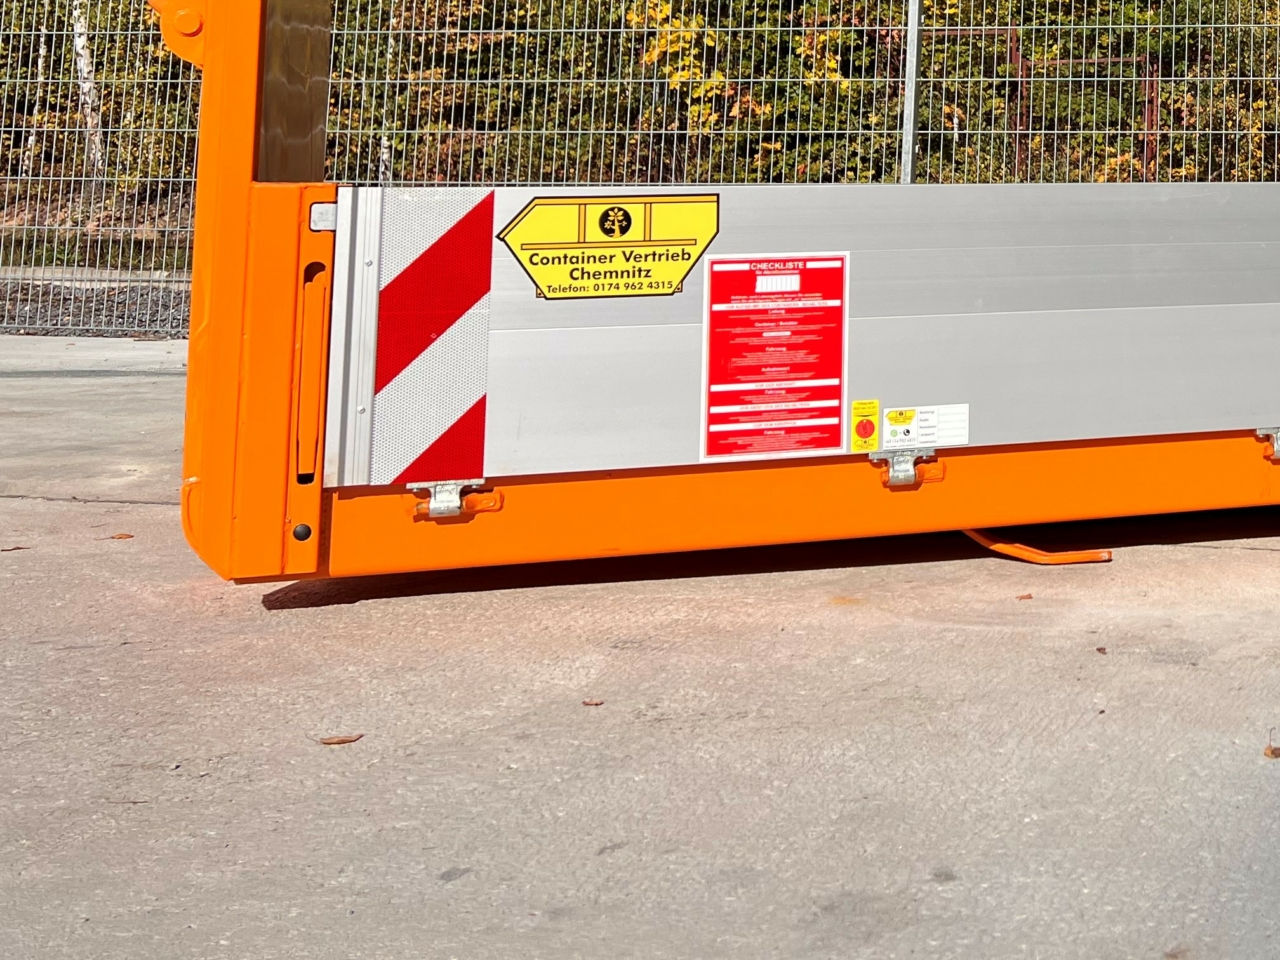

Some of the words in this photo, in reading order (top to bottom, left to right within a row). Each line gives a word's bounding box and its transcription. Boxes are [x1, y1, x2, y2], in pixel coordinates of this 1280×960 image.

[528, 251, 617, 266] Container
[621, 248, 692, 264] Vertrieb
[569, 265, 653, 281] Chemnitz
[750, 261, 805, 270] CHECKLISTE
[546, 283, 591, 294] Telefon:
[593, 282, 621, 292] 0174
[623, 281, 644, 291] 962
[646, 280, 674, 290] 4315
